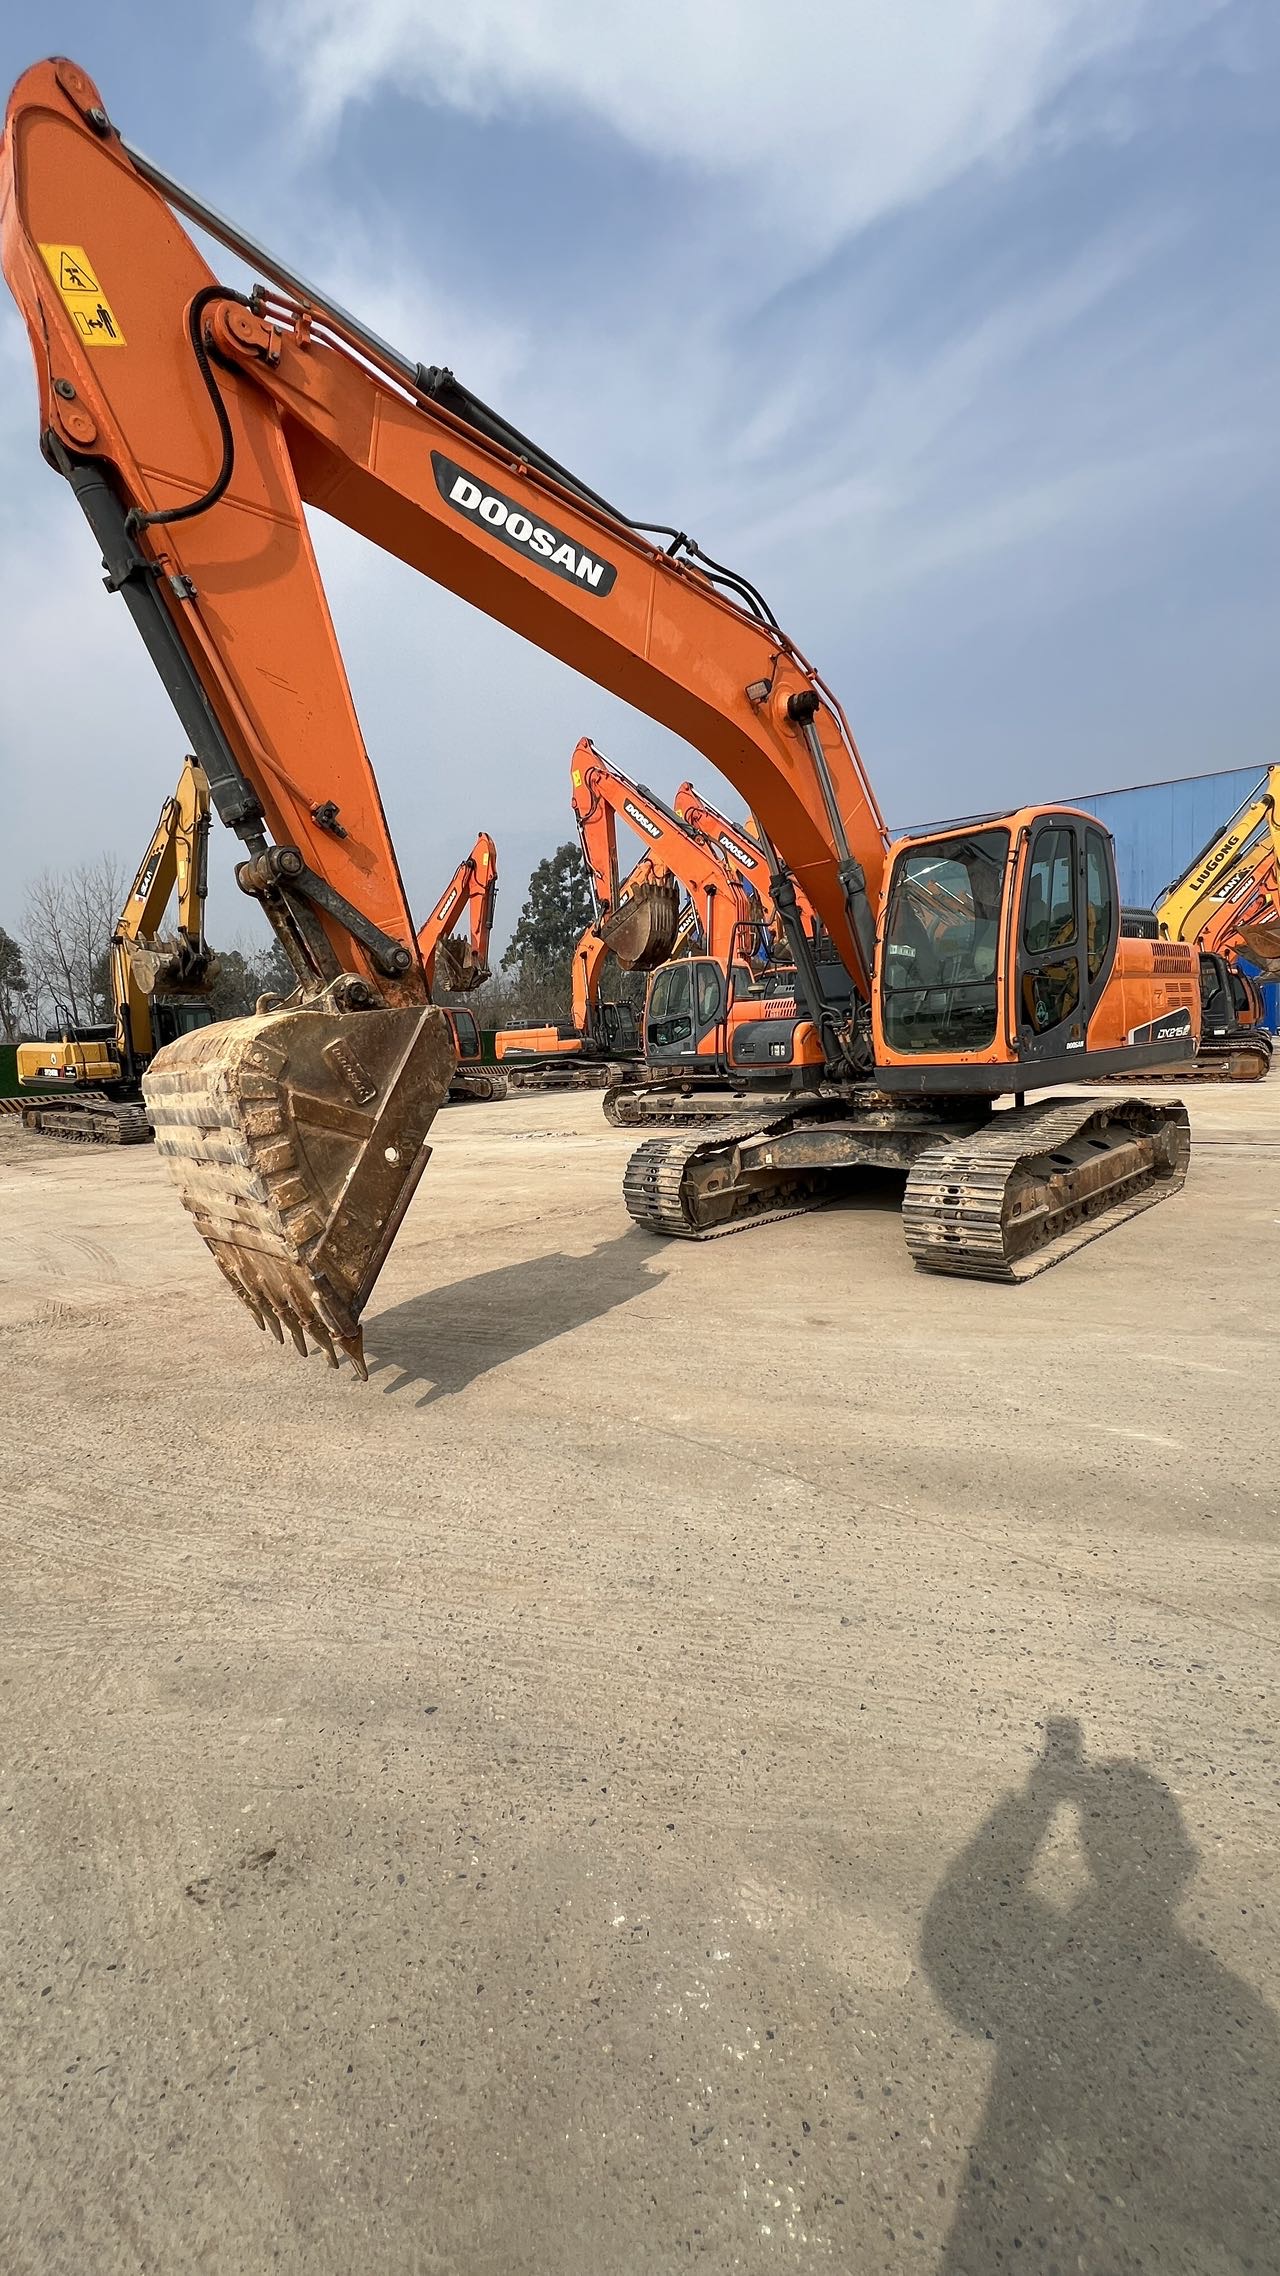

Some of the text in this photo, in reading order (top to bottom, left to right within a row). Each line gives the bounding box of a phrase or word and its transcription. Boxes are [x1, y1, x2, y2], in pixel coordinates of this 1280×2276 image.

[449, 476, 604, 587] DOOSAN
[625, 803, 660, 837] DOOSAN
[720, 836, 755, 868] DOOSAN
[1189, 835, 1240, 891] LIUGONG
[1218, 873, 1241, 898] SANY
